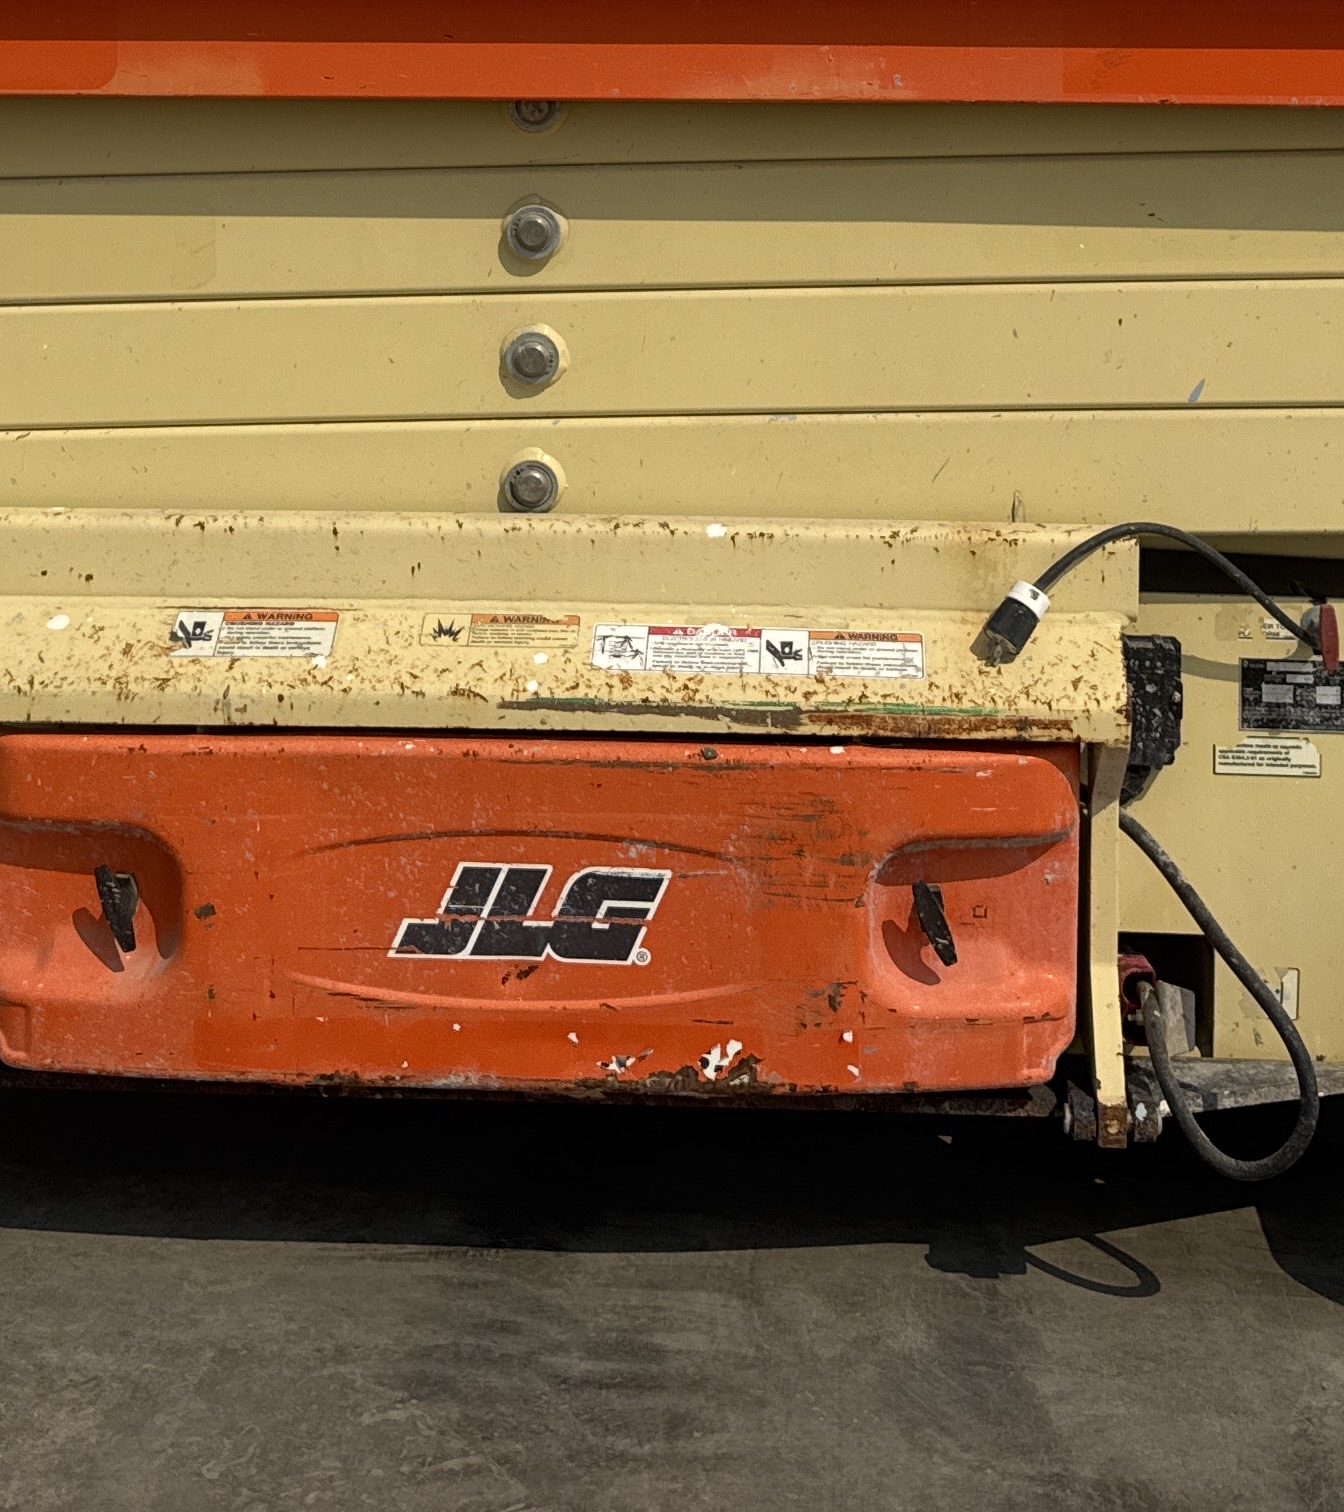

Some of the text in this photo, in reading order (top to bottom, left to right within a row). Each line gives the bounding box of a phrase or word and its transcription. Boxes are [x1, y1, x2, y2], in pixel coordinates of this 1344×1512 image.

[256, 612, 314, 621] WARNING
[503, 614, 560, 624] WARNIN
[848, 632, 899, 642] WARNING
[387, 861, 673, 965] JLG
